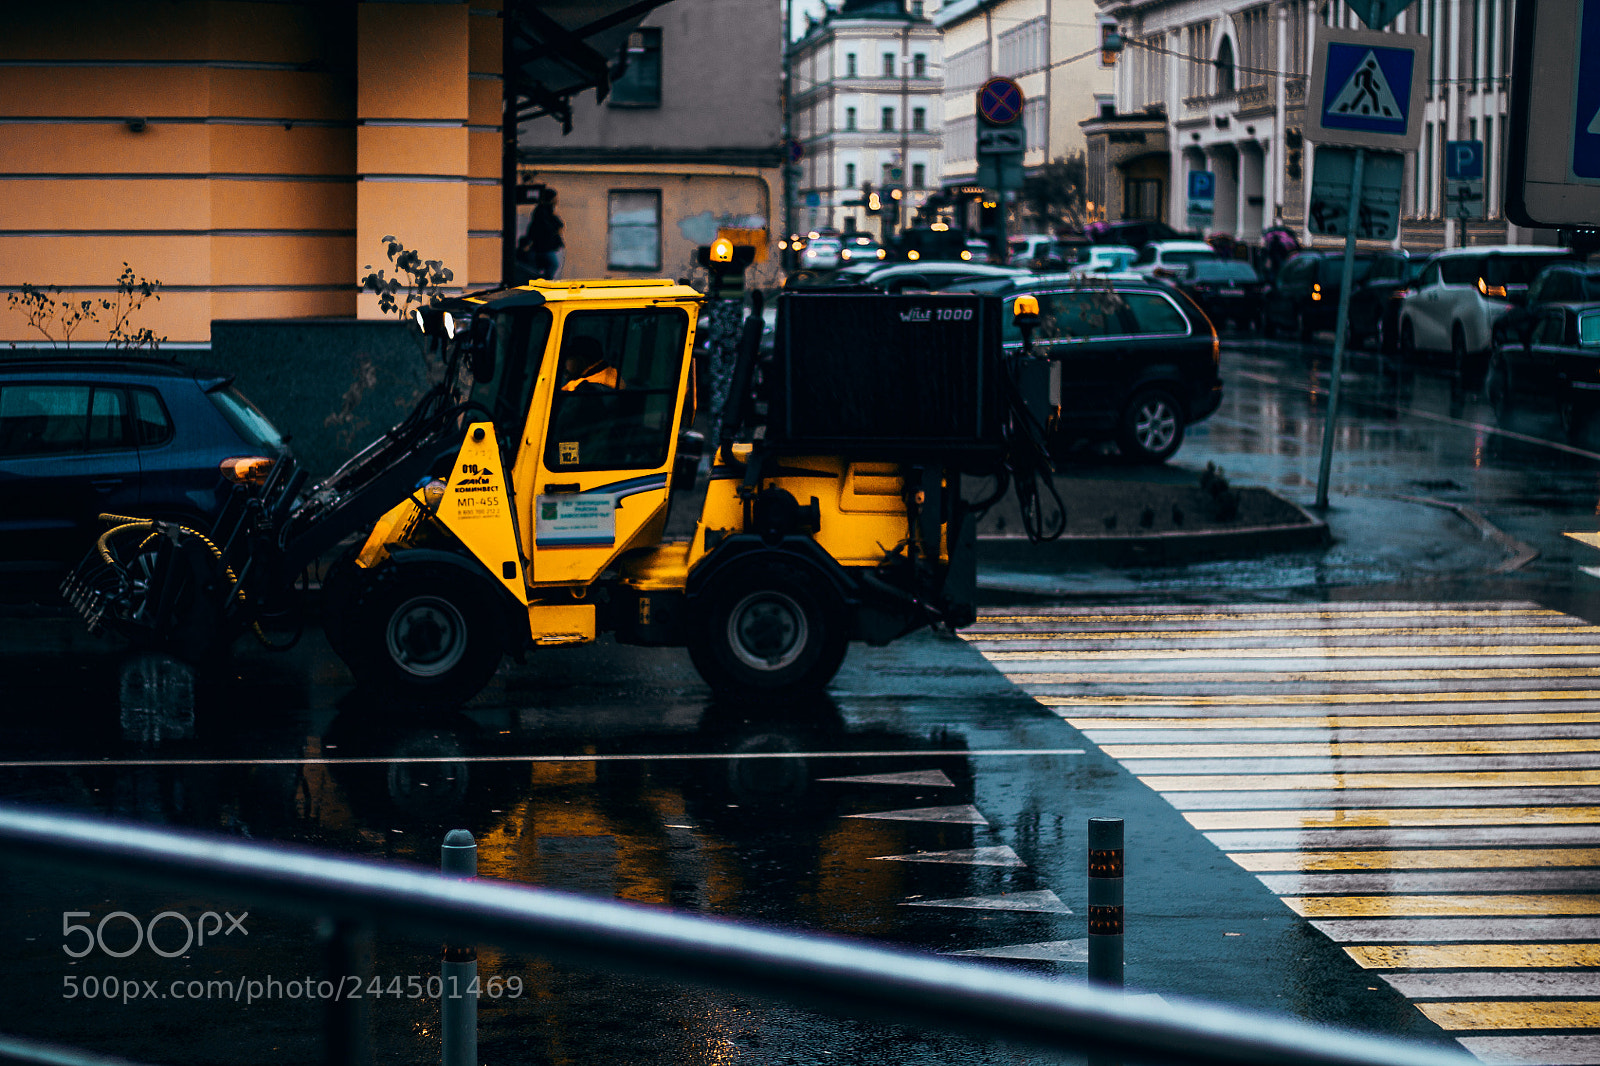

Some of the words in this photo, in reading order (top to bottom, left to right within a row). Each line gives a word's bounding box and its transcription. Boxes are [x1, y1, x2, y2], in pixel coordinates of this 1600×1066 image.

[1456, 147, 1474, 174] P
[936, 309, 973, 320] 1000
[462, 464, 478, 474] 010
[457, 497, 499, 507] МП-455
